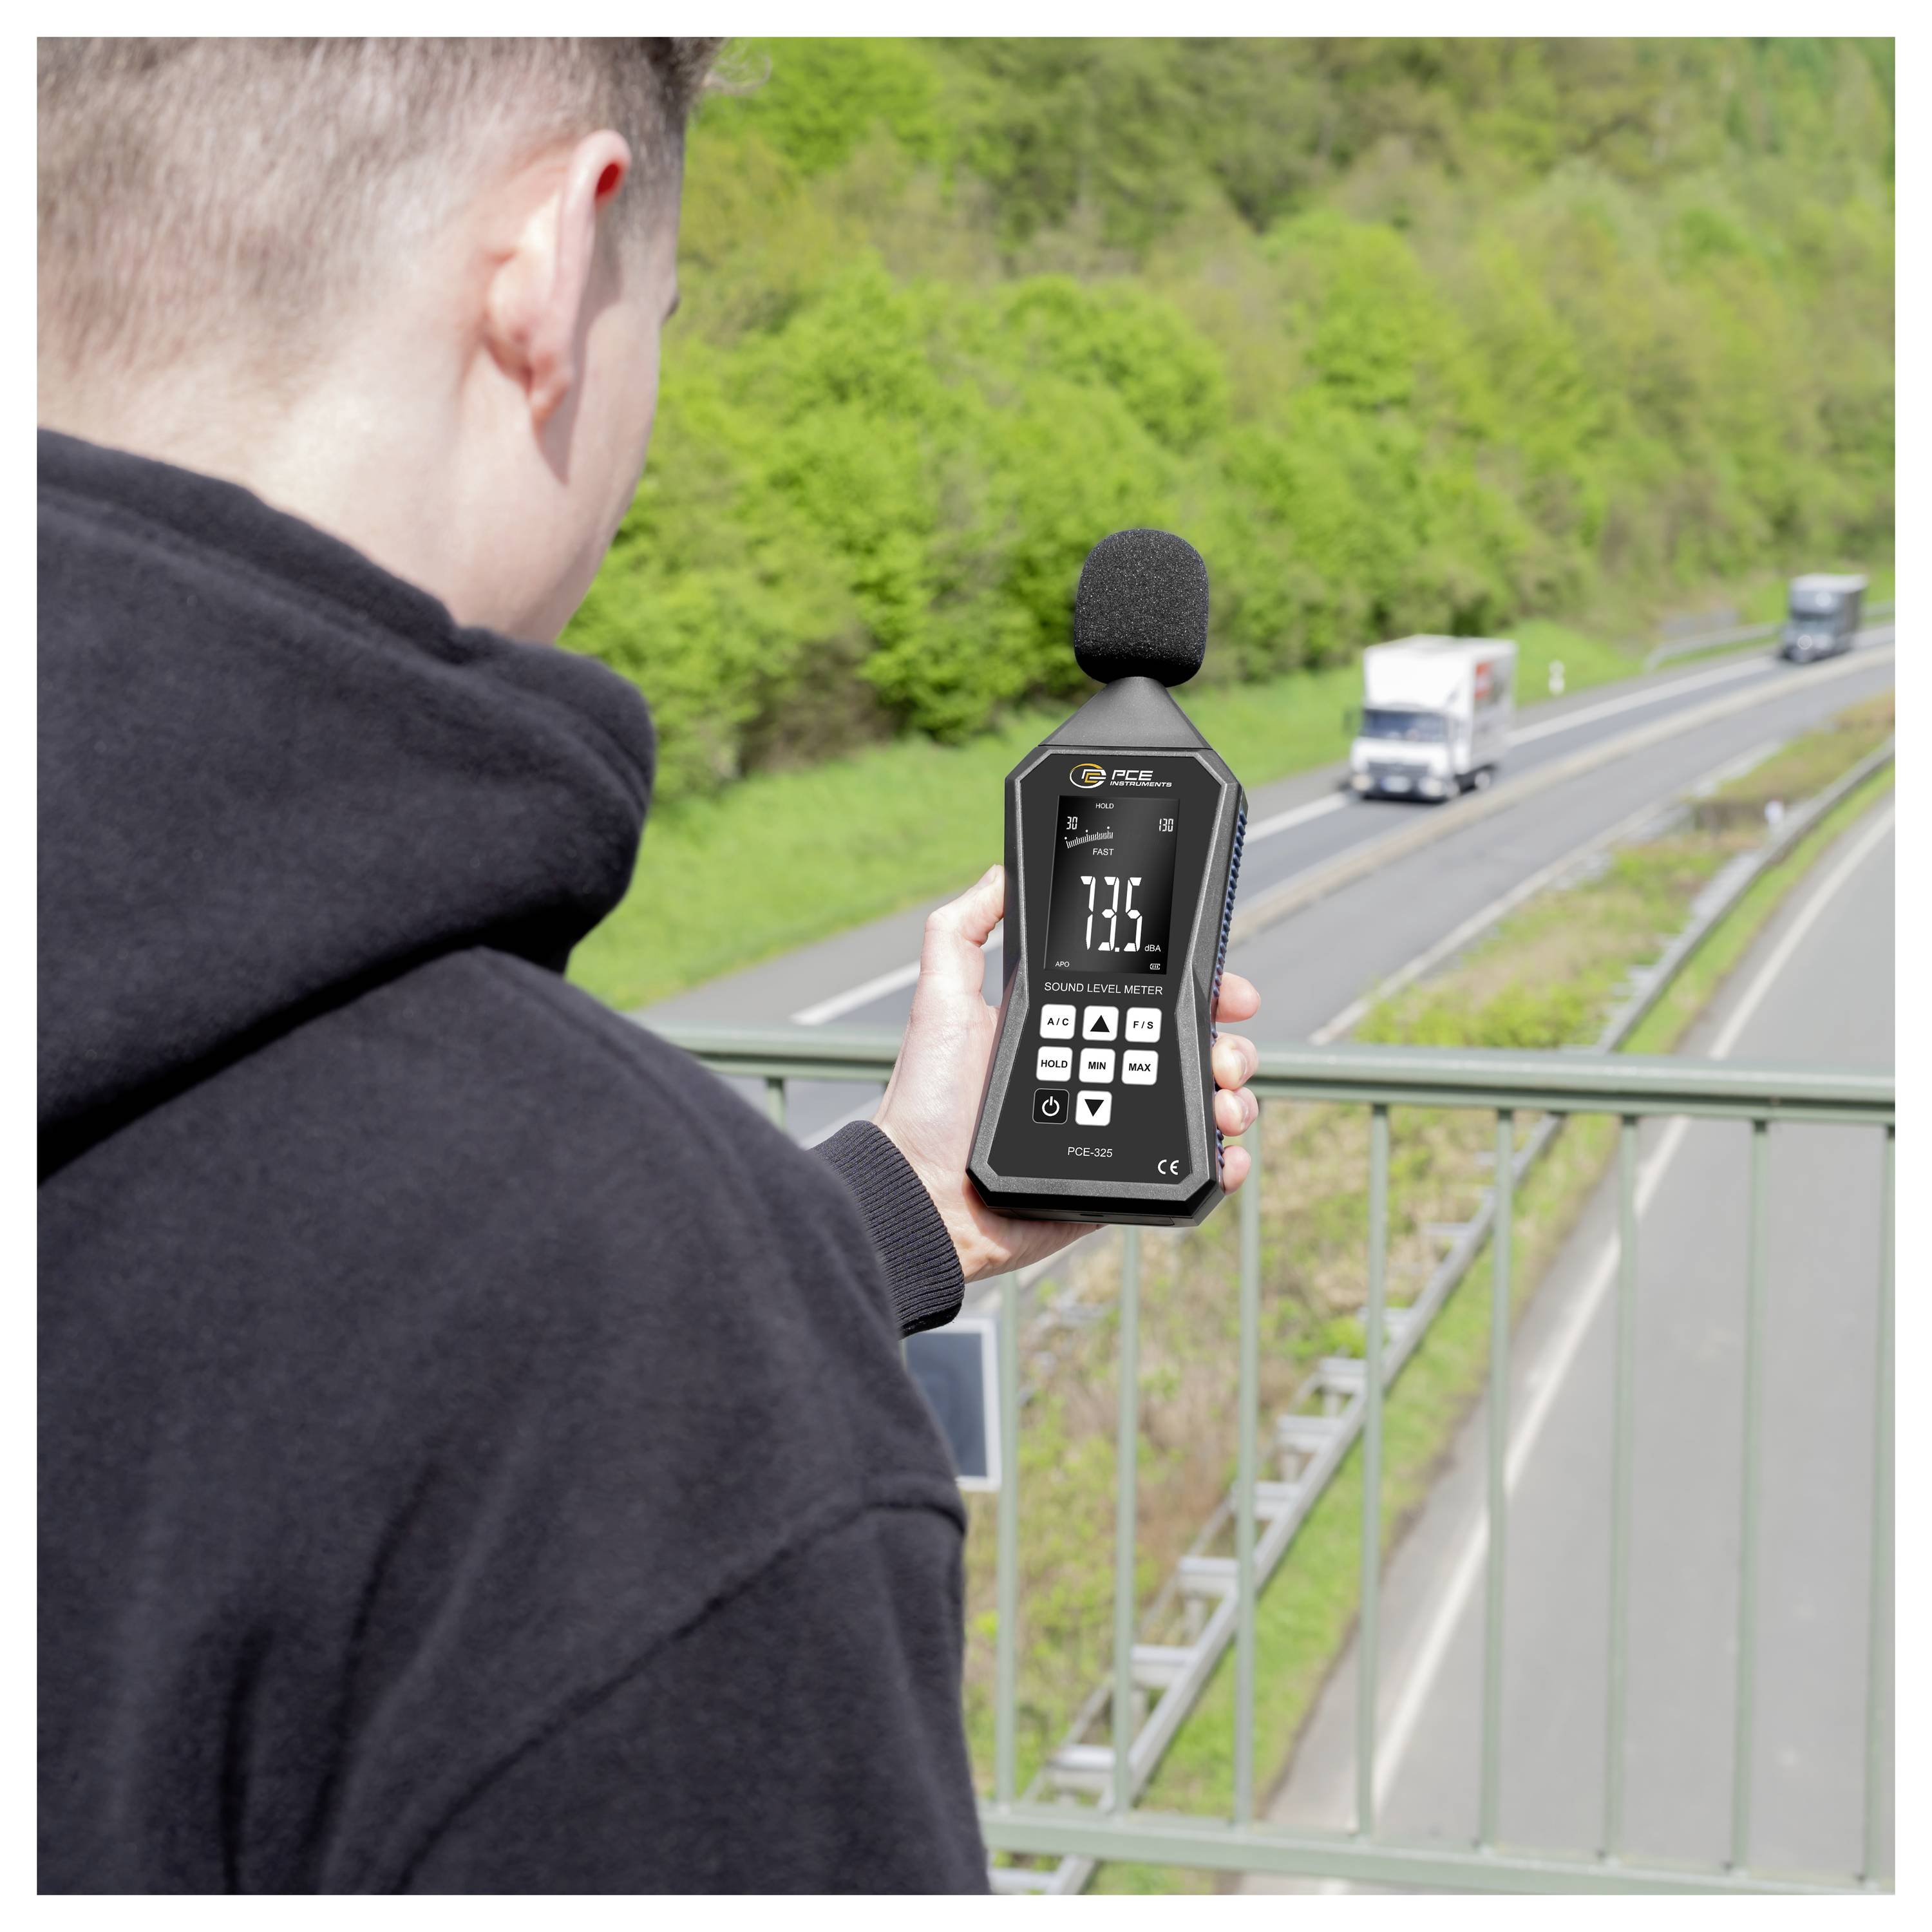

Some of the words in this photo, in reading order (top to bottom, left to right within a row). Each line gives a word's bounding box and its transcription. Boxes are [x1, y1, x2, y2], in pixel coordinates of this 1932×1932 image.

[1112, 770, 1153, 781] PCE
[1066, 817, 1077, 829] 30
[1159, 819, 1173, 831] 130
[1081, 876, 1142, 952] 73.5
[1045, 982, 1083, 992] SOUND
[1088, 984, 1121, 993] LEVEL
[1124, 985, 1162, 994] METER
[1129, 1063, 1150, 1072] MAX
[1068, 1147, 1112, 1157] PCE-325
